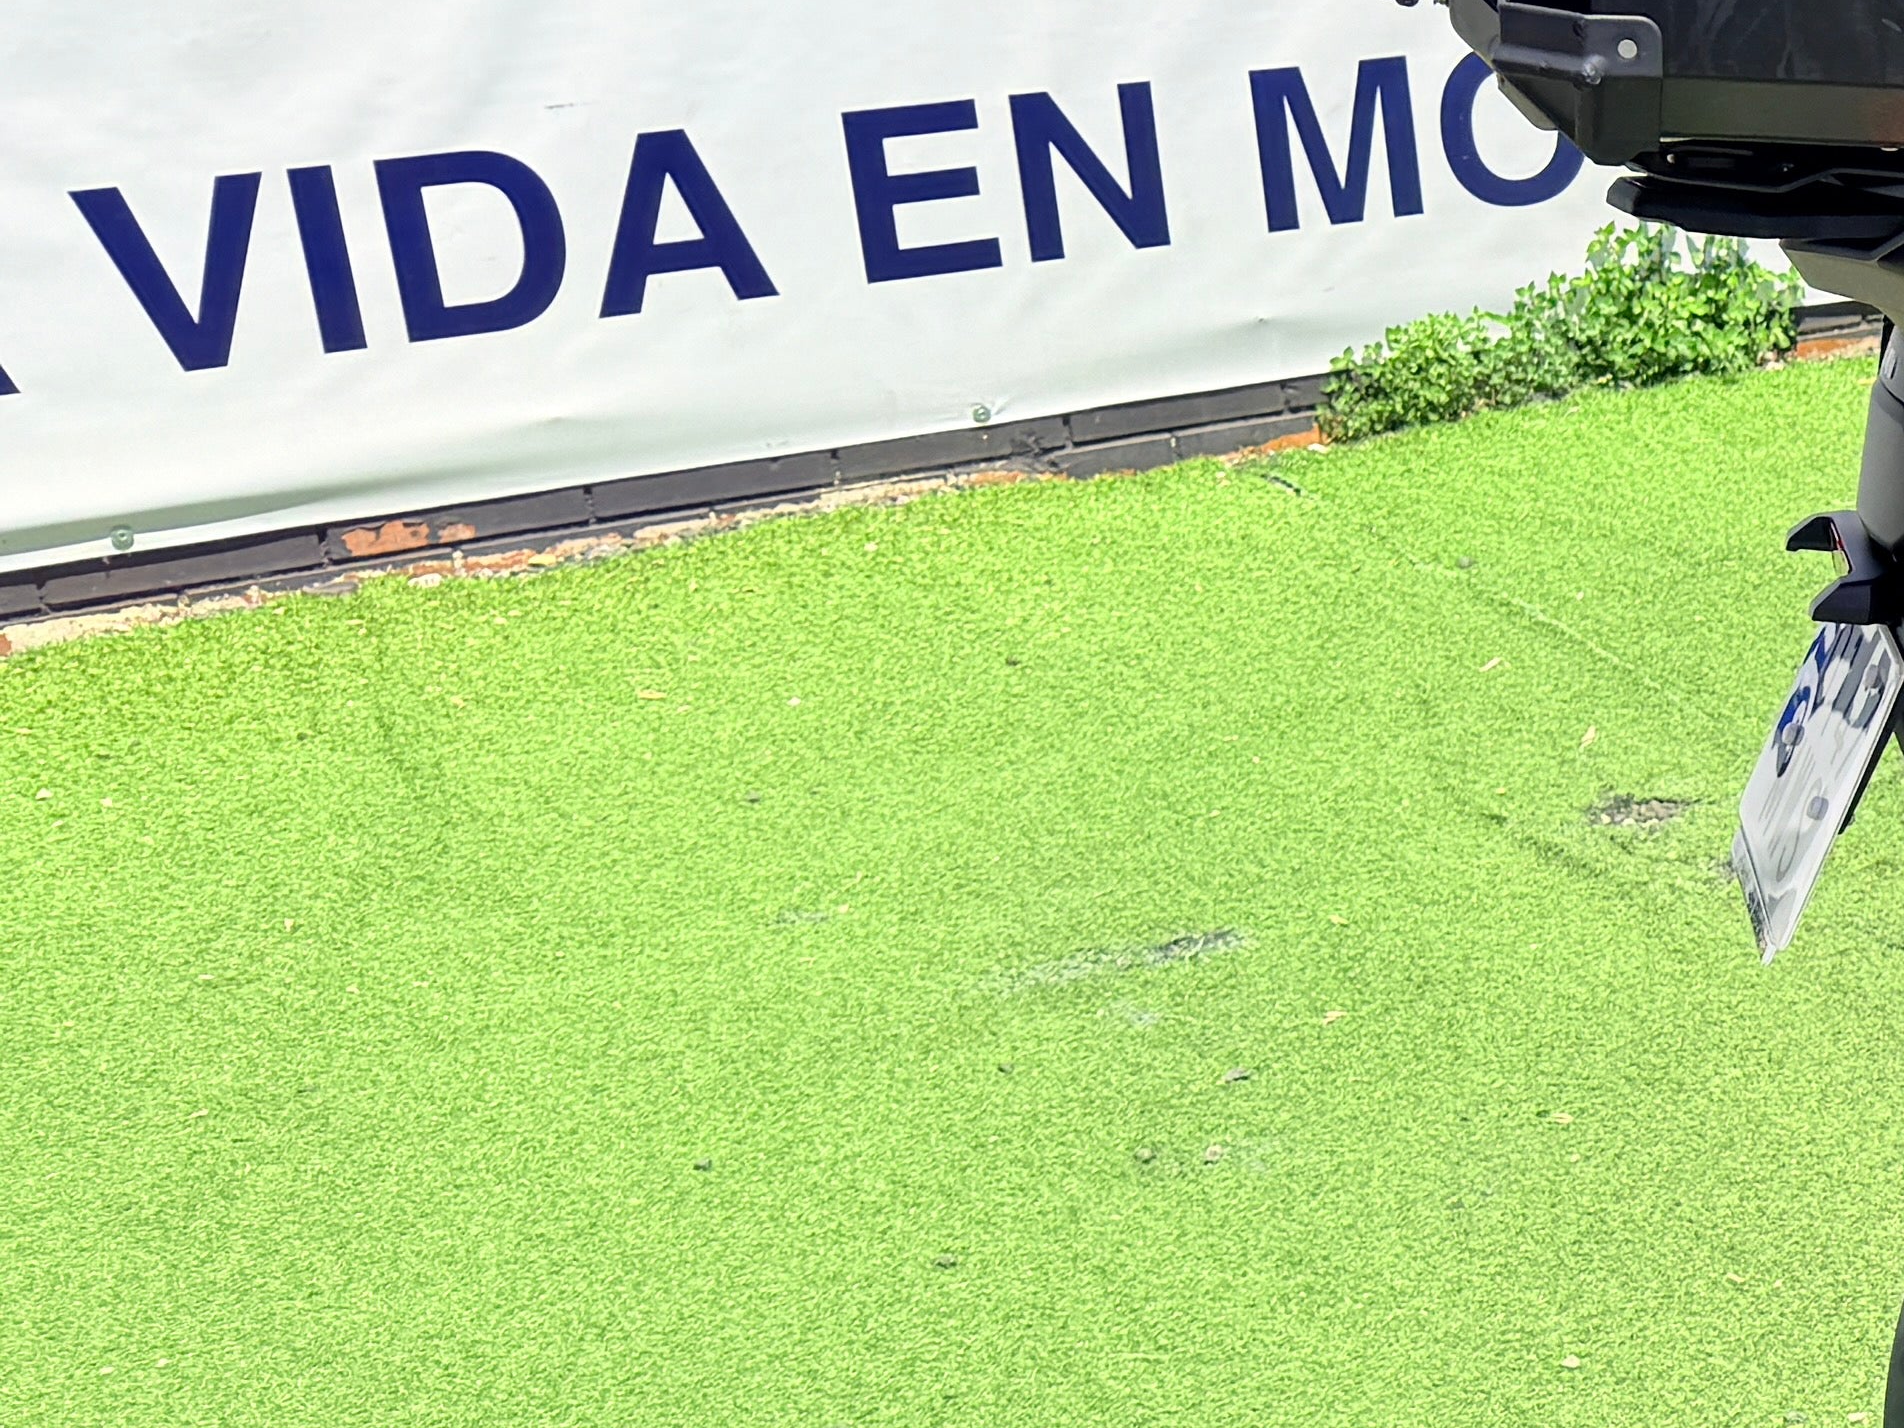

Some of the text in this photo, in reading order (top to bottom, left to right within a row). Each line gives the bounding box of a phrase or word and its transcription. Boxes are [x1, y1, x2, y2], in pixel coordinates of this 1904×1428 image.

[71, 52, 1586, 372] VIDA EN MO
